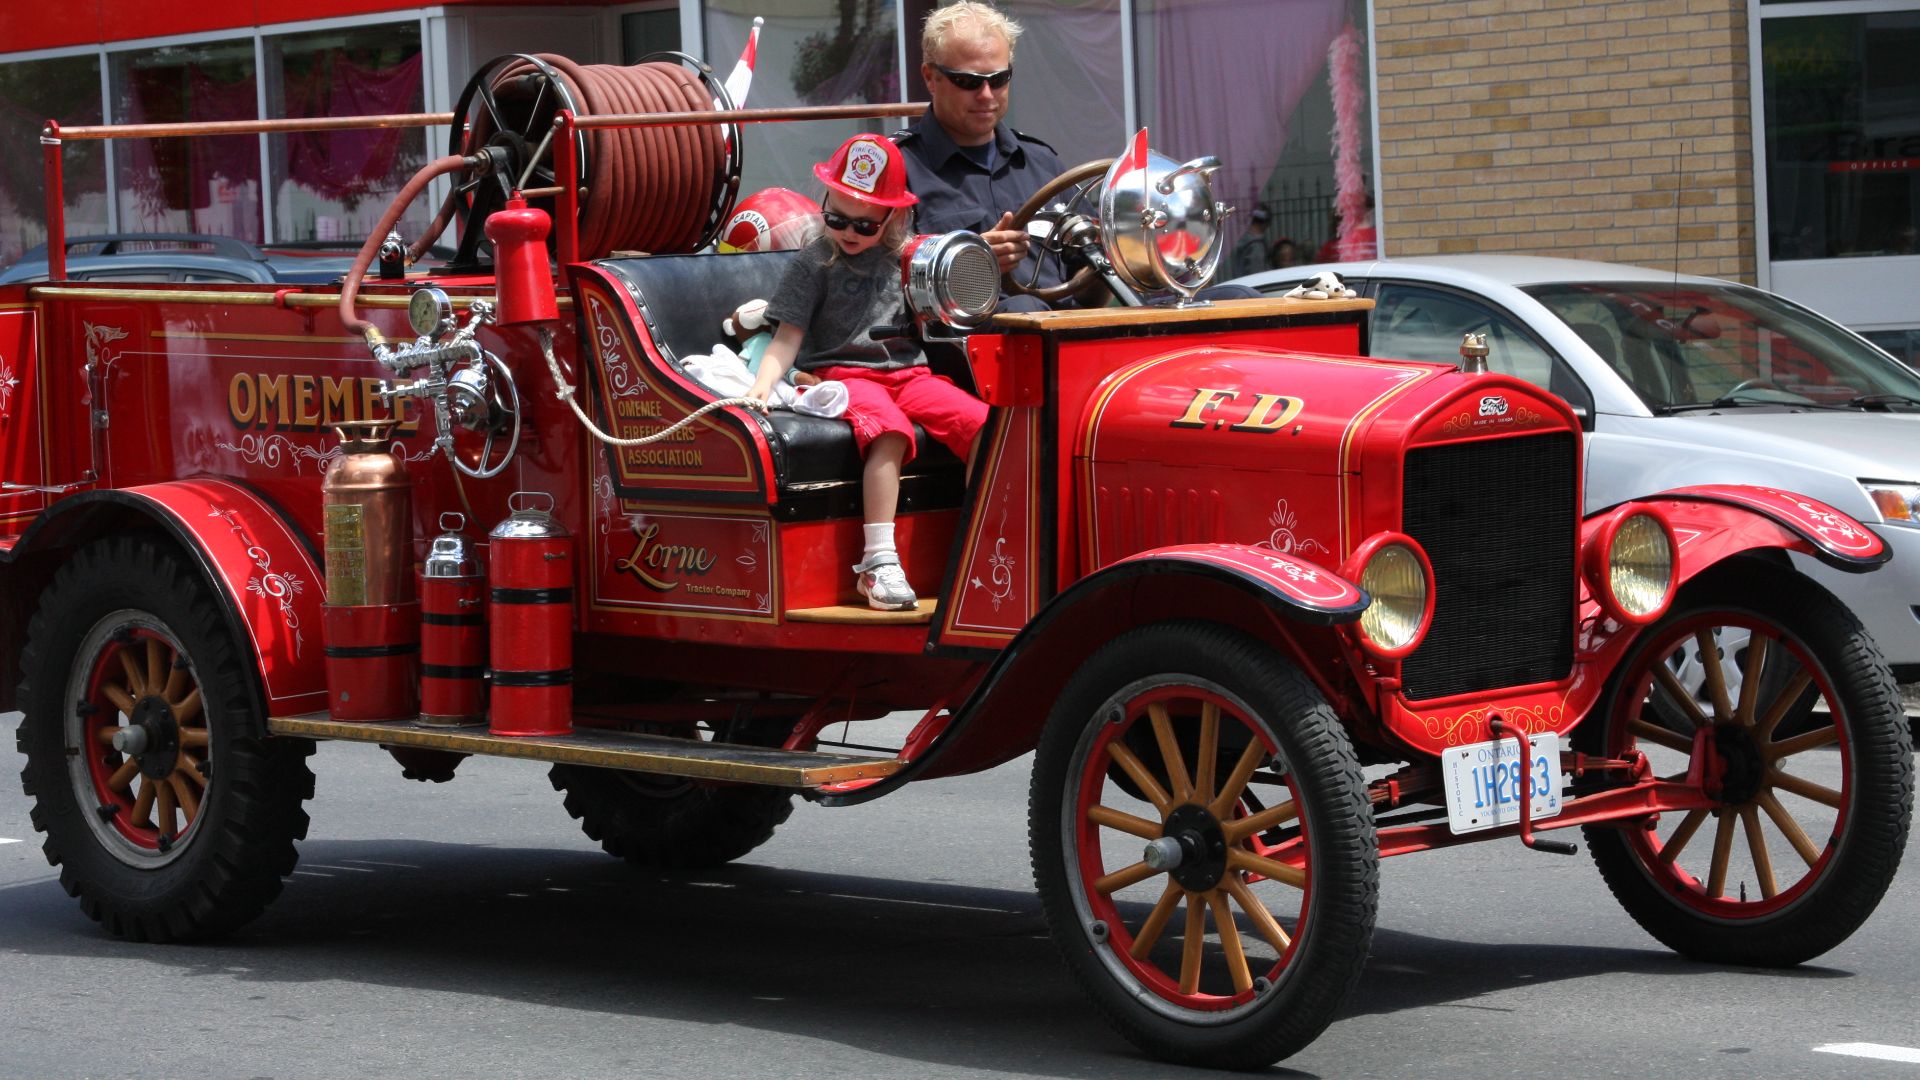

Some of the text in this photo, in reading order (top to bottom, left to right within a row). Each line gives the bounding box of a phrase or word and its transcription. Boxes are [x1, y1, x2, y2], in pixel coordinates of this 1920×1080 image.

[1850, 160, 1908, 170] OFFICE
[733, 212, 767, 234] CAPTAIN
[229, 372, 421, 431] OMEMEE
[618, 401, 662, 417] OMEMEE
[1479, 396, 1508, 416] Ford
[628, 449, 703, 466] ASSOCIATION
[615, 522, 718, 590] Lorne
[686, 583, 751, 598] Tractor Company
[1452, 762, 1464, 817] HISTORIC
